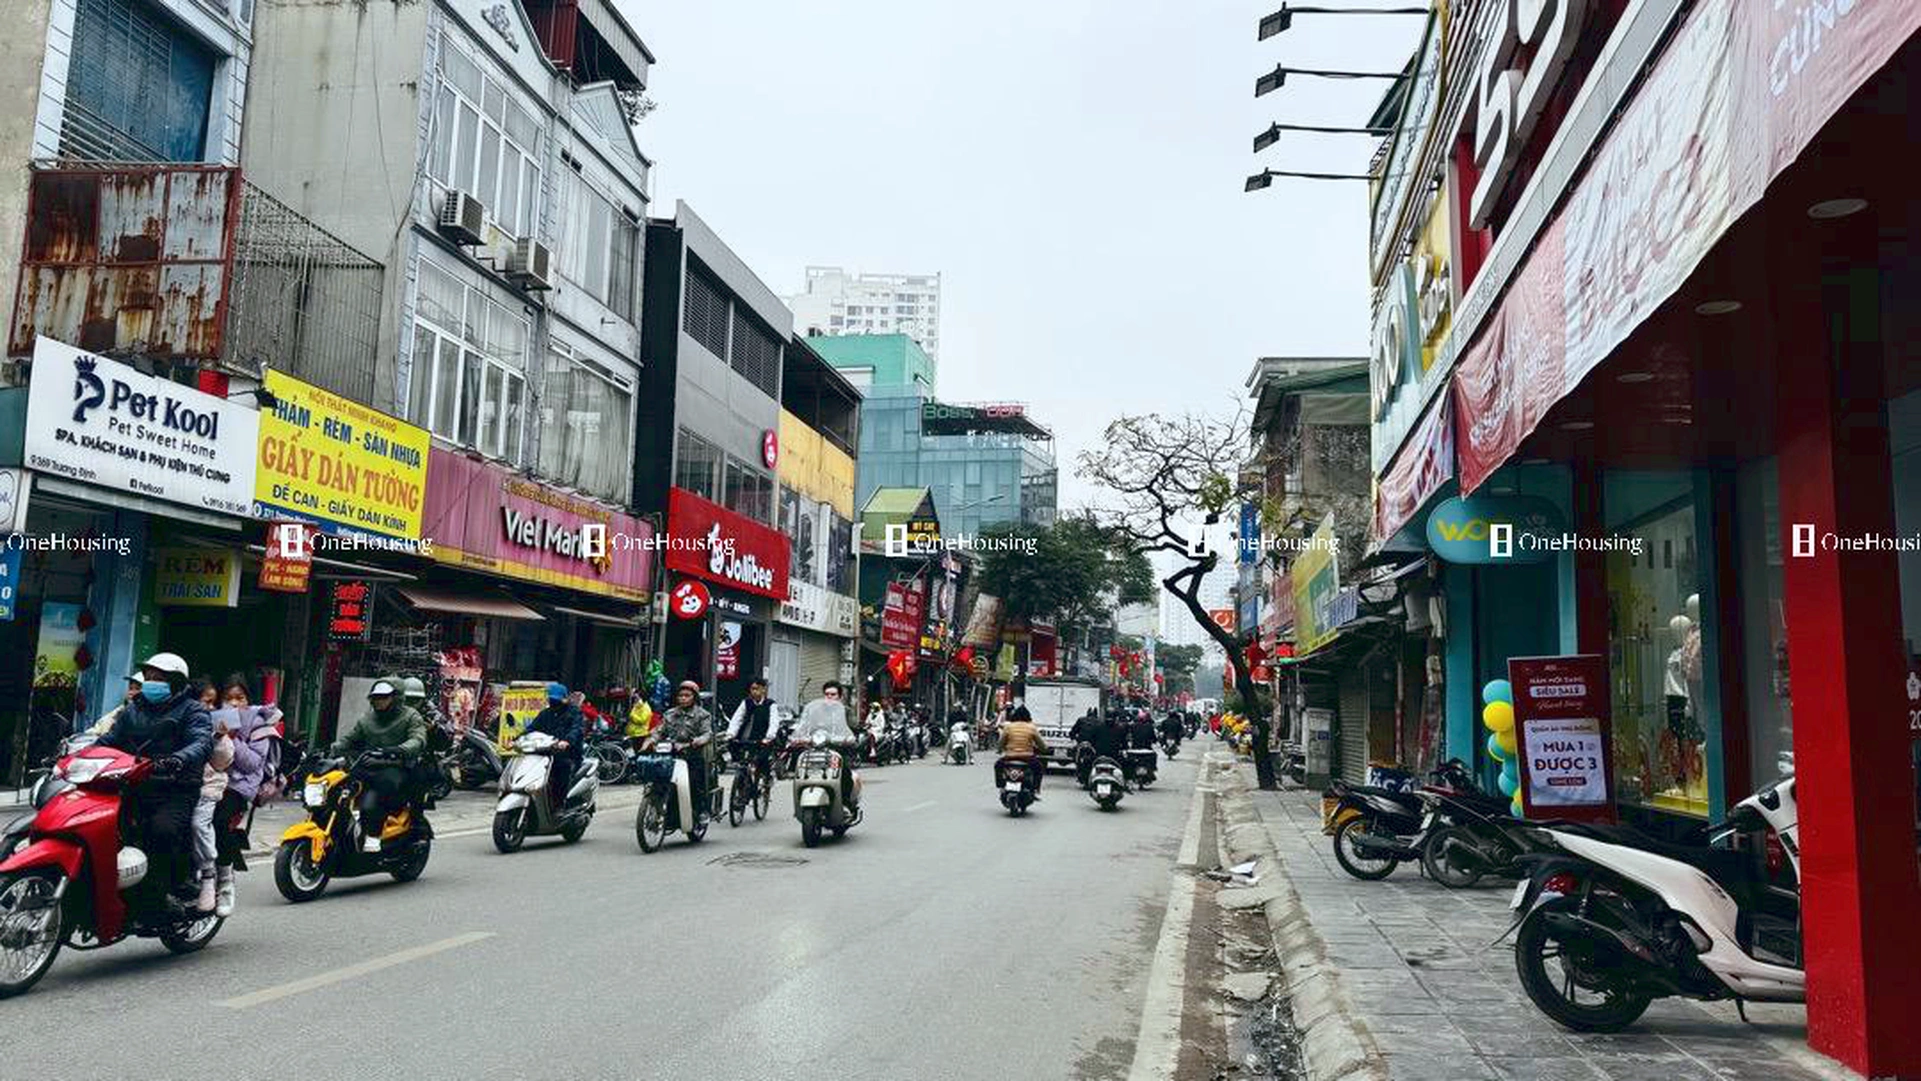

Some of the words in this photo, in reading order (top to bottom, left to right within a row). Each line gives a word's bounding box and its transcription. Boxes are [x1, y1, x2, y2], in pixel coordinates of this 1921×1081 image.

[109, 379, 158, 421] Pet
[163, 397, 218, 440] Kool
[108, 416, 131, 436] Pet
[136, 424, 177, 449] Sweet
[182, 438, 216, 460] Home
[261, 431, 315, 481] GIẤY
[317, 452, 359, 495] DÁN
[362, 470, 419, 512] TƯỜNG
[293, 490, 319, 509] CAN
[1436, 518, 1491, 541] WO
[724, 550, 773, 590] Jollibee
[1543, 741, 1576, 753] MUA
[1578, 741, 1584, 752] 1
[1534, 757, 1584, 774] ĐƯỢC
[1587, 757, 1598, 770] 3
